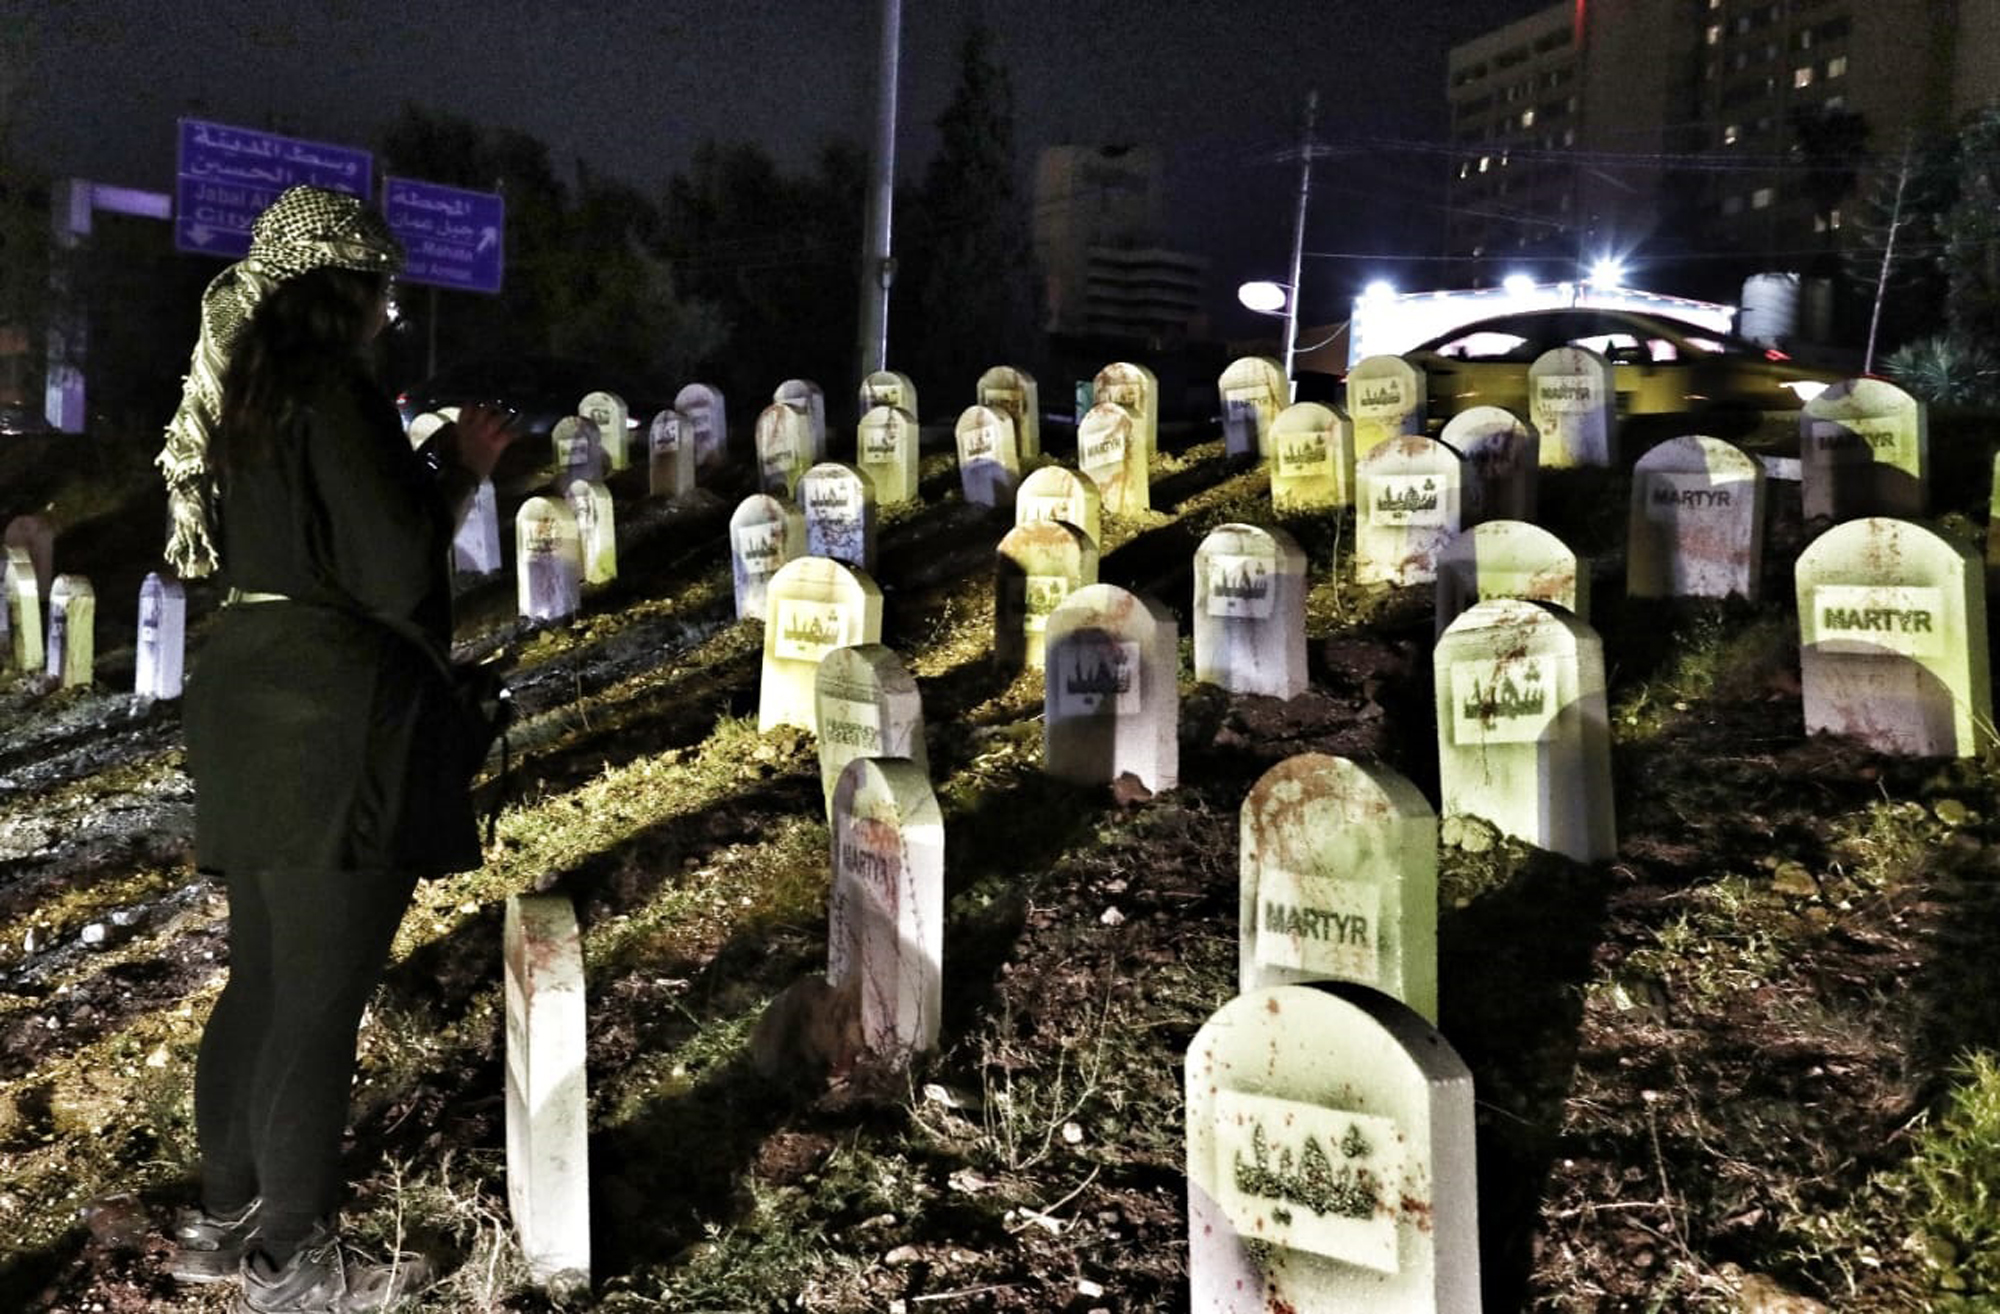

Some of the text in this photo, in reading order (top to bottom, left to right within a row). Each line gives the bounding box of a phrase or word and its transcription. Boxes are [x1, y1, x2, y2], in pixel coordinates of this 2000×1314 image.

[192, 124, 357, 176] وسط المدينة
[195, 183, 246, 207] Jabal
[195, 206, 255, 229] City
[1541, 386, 1591, 401] MARTYR
[1283, 434, 1327, 471] شهيد
[1376, 477, 1438, 519] شهيد
[1653, 487, 1731, 509] MARTYR
[1213, 561, 1268, 608] شهيد
[783, 609, 840, 651] شهيد
[1823, 607, 1934, 633] MARTYR
[1463, 661, 1546, 731] شهيد
[1264, 900, 1370, 948] MARTYR
[1233, 1120, 1376, 1226] شهيد
